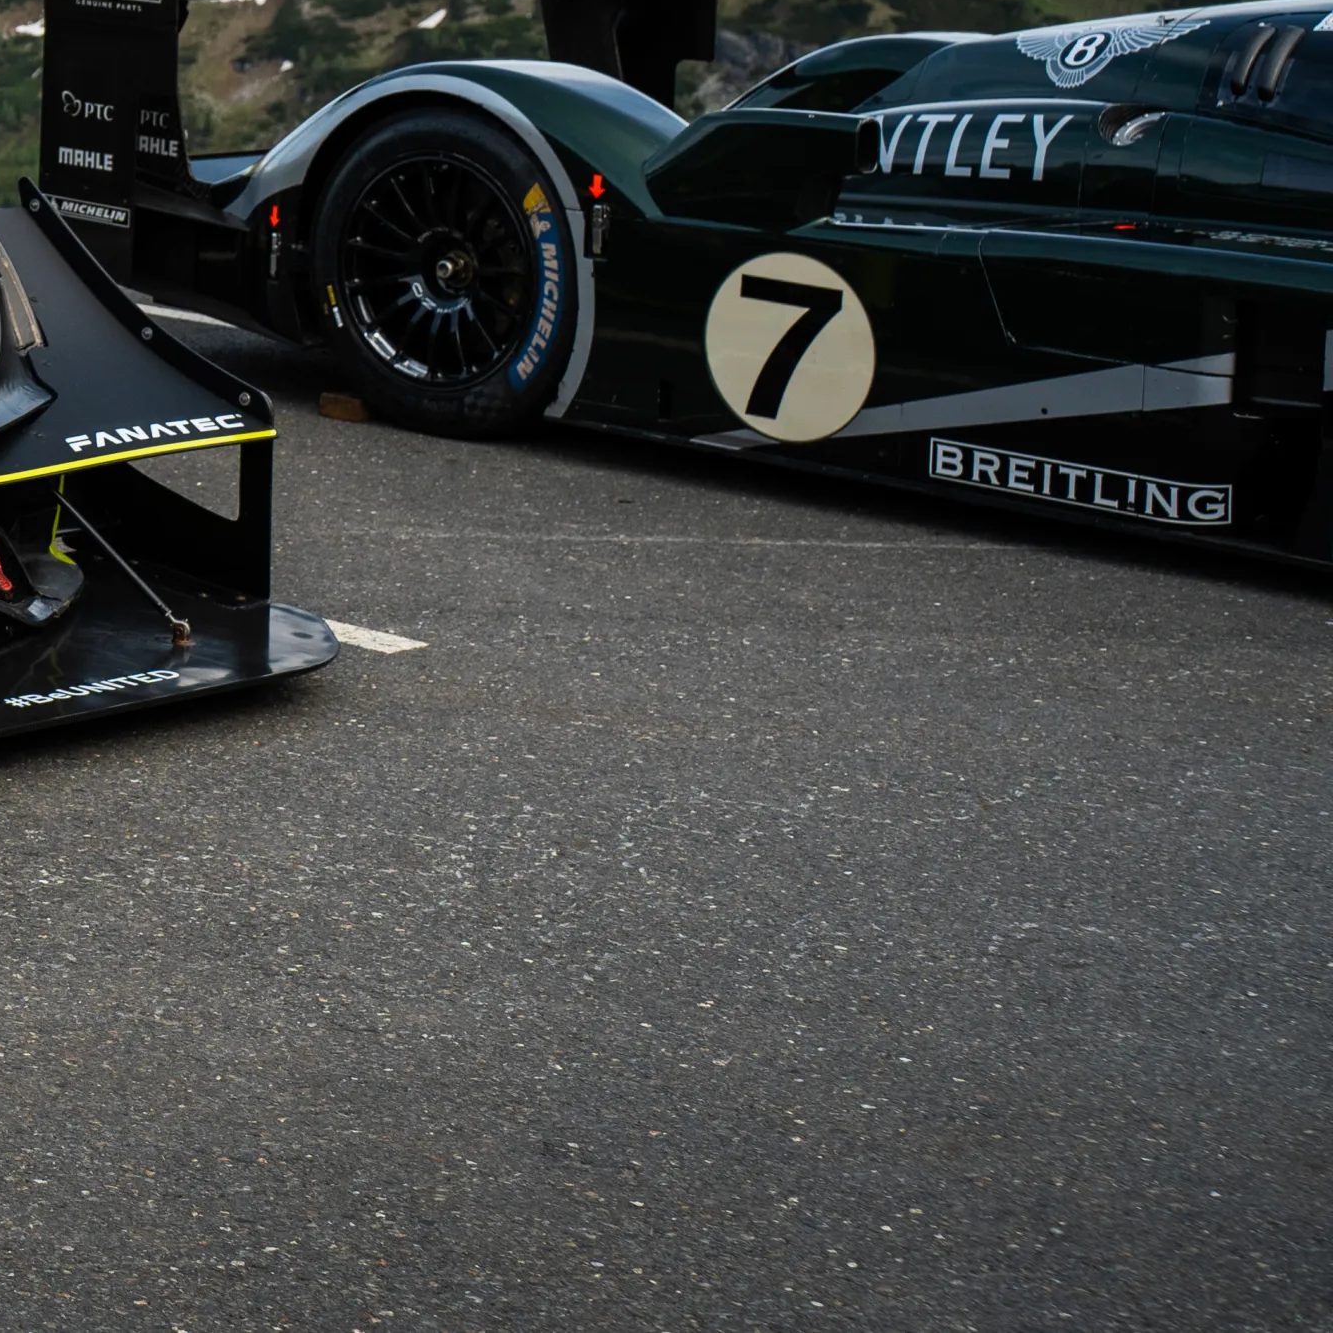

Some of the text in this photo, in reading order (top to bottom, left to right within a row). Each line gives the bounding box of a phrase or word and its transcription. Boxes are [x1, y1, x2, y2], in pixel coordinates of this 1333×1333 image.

[116, 2, 142, 13] PARTS
[83, 101, 115, 122] PTC
[139, 108, 171, 129] PTC
[58, 145, 114, 172] MAHLE
[138, 134, 180, 158] AHLE
[878, 113, 1076, 182] NTLEY
[60, 200, 127, 223] MICHELIN
[516, 241, 560, 382] MICHELIN
[739, 273, 844, 421] 7
[64, 413, 246, 453] FANATEC
[934, 443, 1226, 521] BREITLING
[3, 669, 181, 709] #BeUNITED
